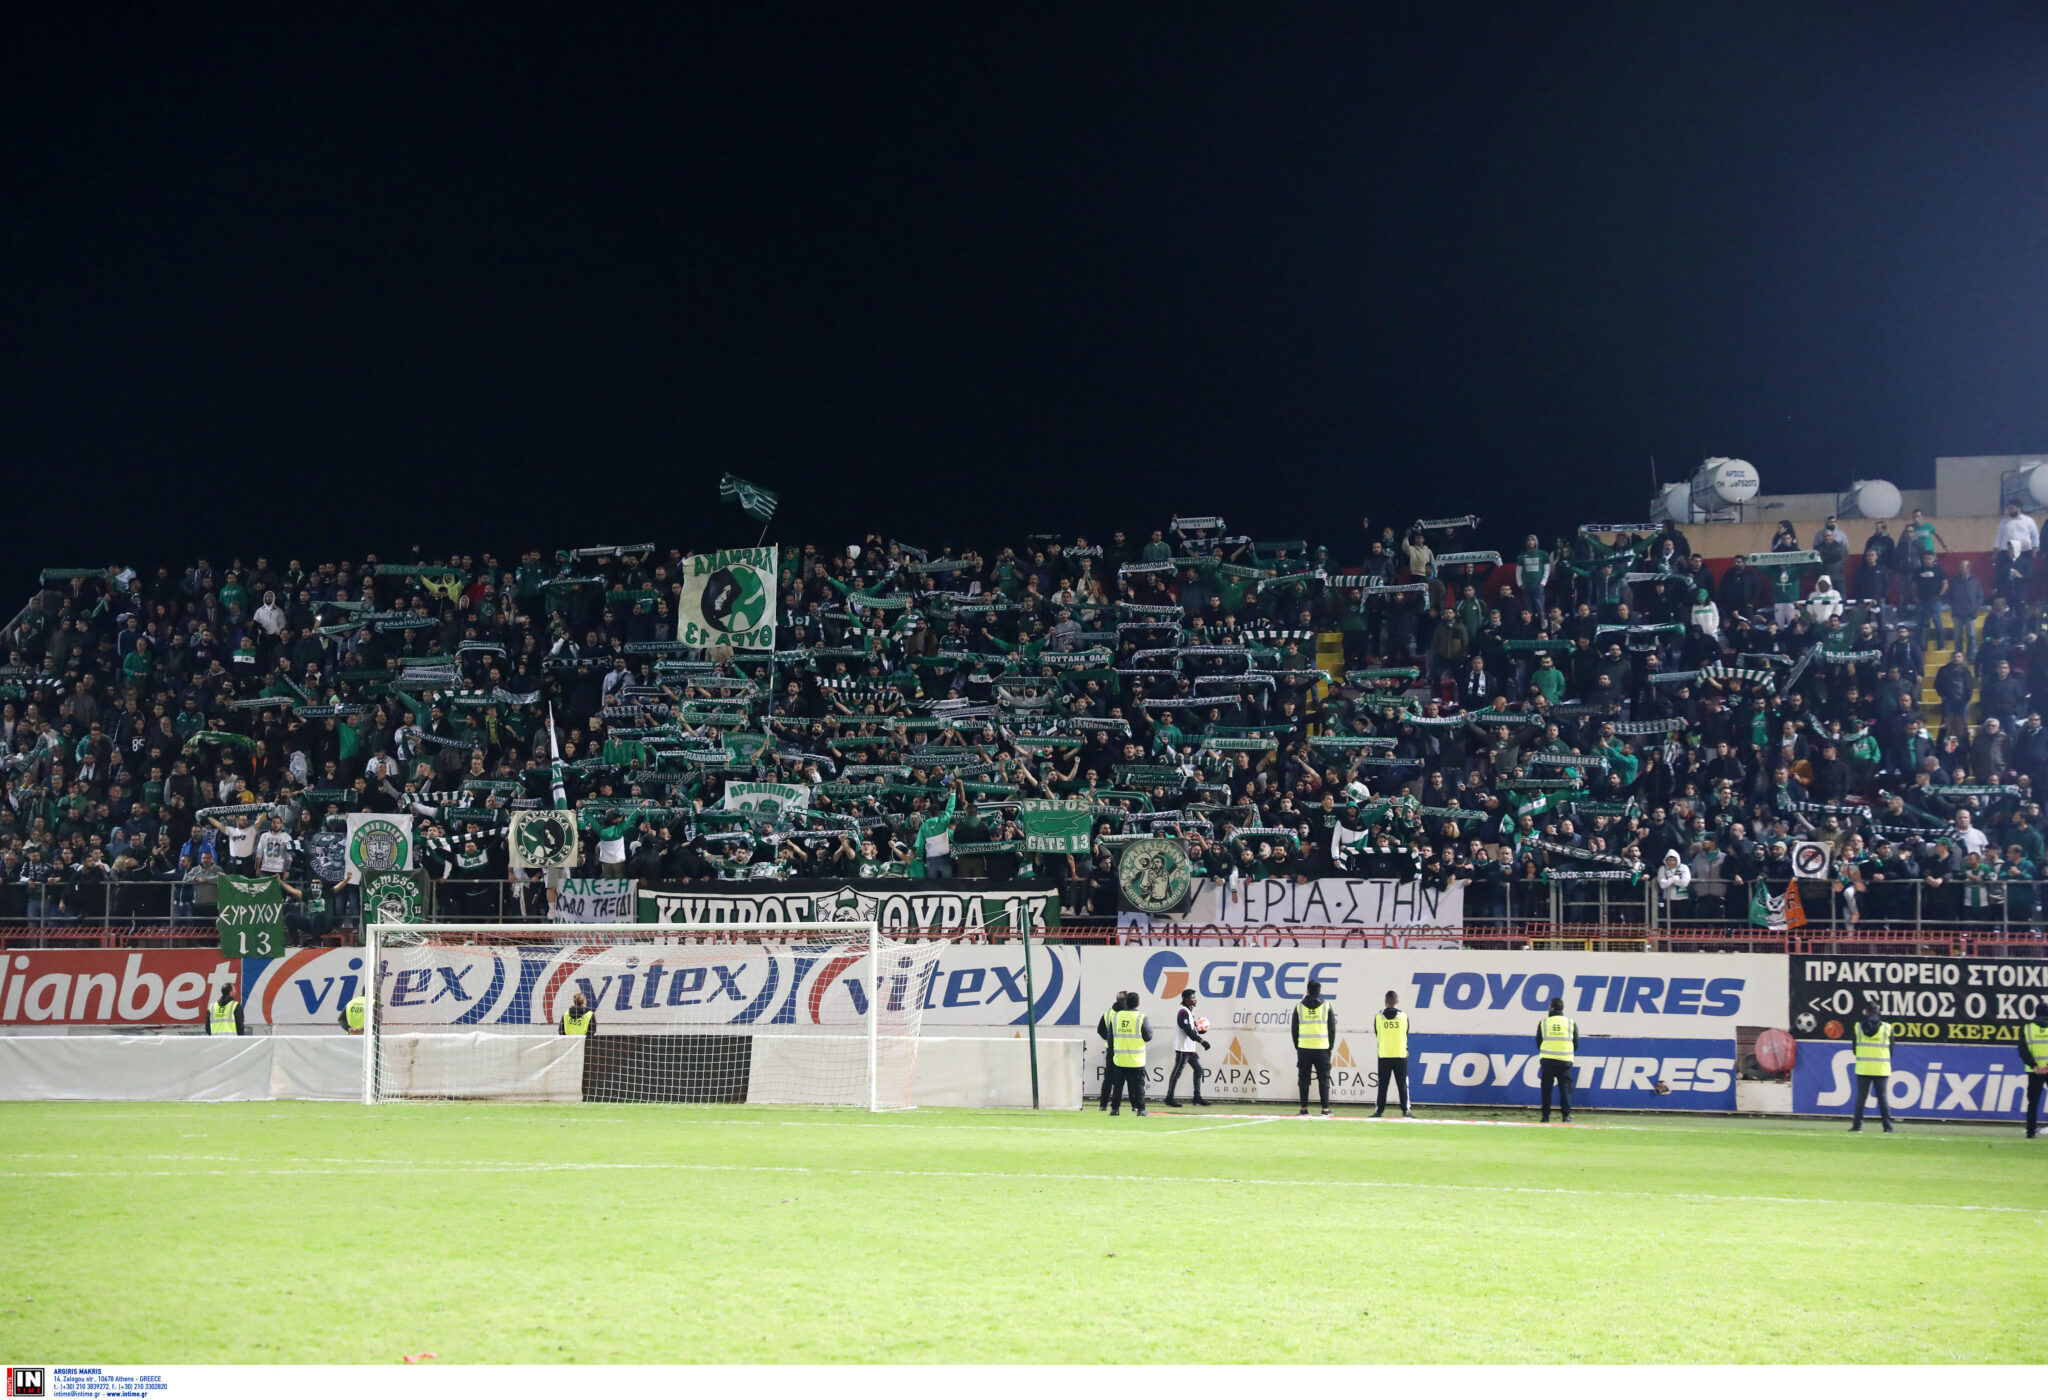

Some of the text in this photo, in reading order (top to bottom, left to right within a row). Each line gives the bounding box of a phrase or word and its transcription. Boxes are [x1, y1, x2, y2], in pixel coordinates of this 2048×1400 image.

[302, 706, 361, 715] ΠΑΝΑΘΗΑΪΚΟΣ
[729, 783, 803, 802] ΑΡΑΔΙΠΠΟΥ
[1024, 800, 1091, 812] PAFOS
[518, 810, 570, 831] ΛΑΡΝΑΚΑ
[1027, 835, 1090, 851] GATE 13
[518, 844, 570, 865] ΘΥΡΑ 13
[365, 873, 421, 897] LEMESOS
[1599, 870, 1626, 879] WEST
[562, 878, 630, 896] ΑΛΕΞΗ
[219, 902, 283, 925] ΕΥΡΥΧΟΥ
[592, 893, 632, 917] ΤΑΞΙΔΙ
[655, 895, 811, 945] ΚΥΠΡΟΣ
[882, 894, 987, 945] ΘΥΡΑ
[1003, 895, 1048, 945] 13
[237, 930, 273, 955] 13
[574, 955, 748, 1013] vitex
[1200, 960, 1342, 1000] GREE
[1805, 961, 1960, 986] ΠΡΑΚΤΟΡΕΙΟ
[843, 955, 1031, 1016] vitex
[1411, 971, 1746, 1017] TOYO TIRES
[1965, 990, 1987, 1019] Ο
[1996, 993, 2048, 1021] ΚΟ
[1232, 1011, 1252, 1024] air
[1383, 1021, 1400, 1029] 053
[1880, 1021, 1940, 1039] ΟΝΟ
[1200, 1067, 1272, 1086] PAPAS
[1571, 1055, 1736, 1093] TIRES
[1214, 1086, 1258, 1094] GROUP
[1331, 1088, 1366, 1096] ROUP
